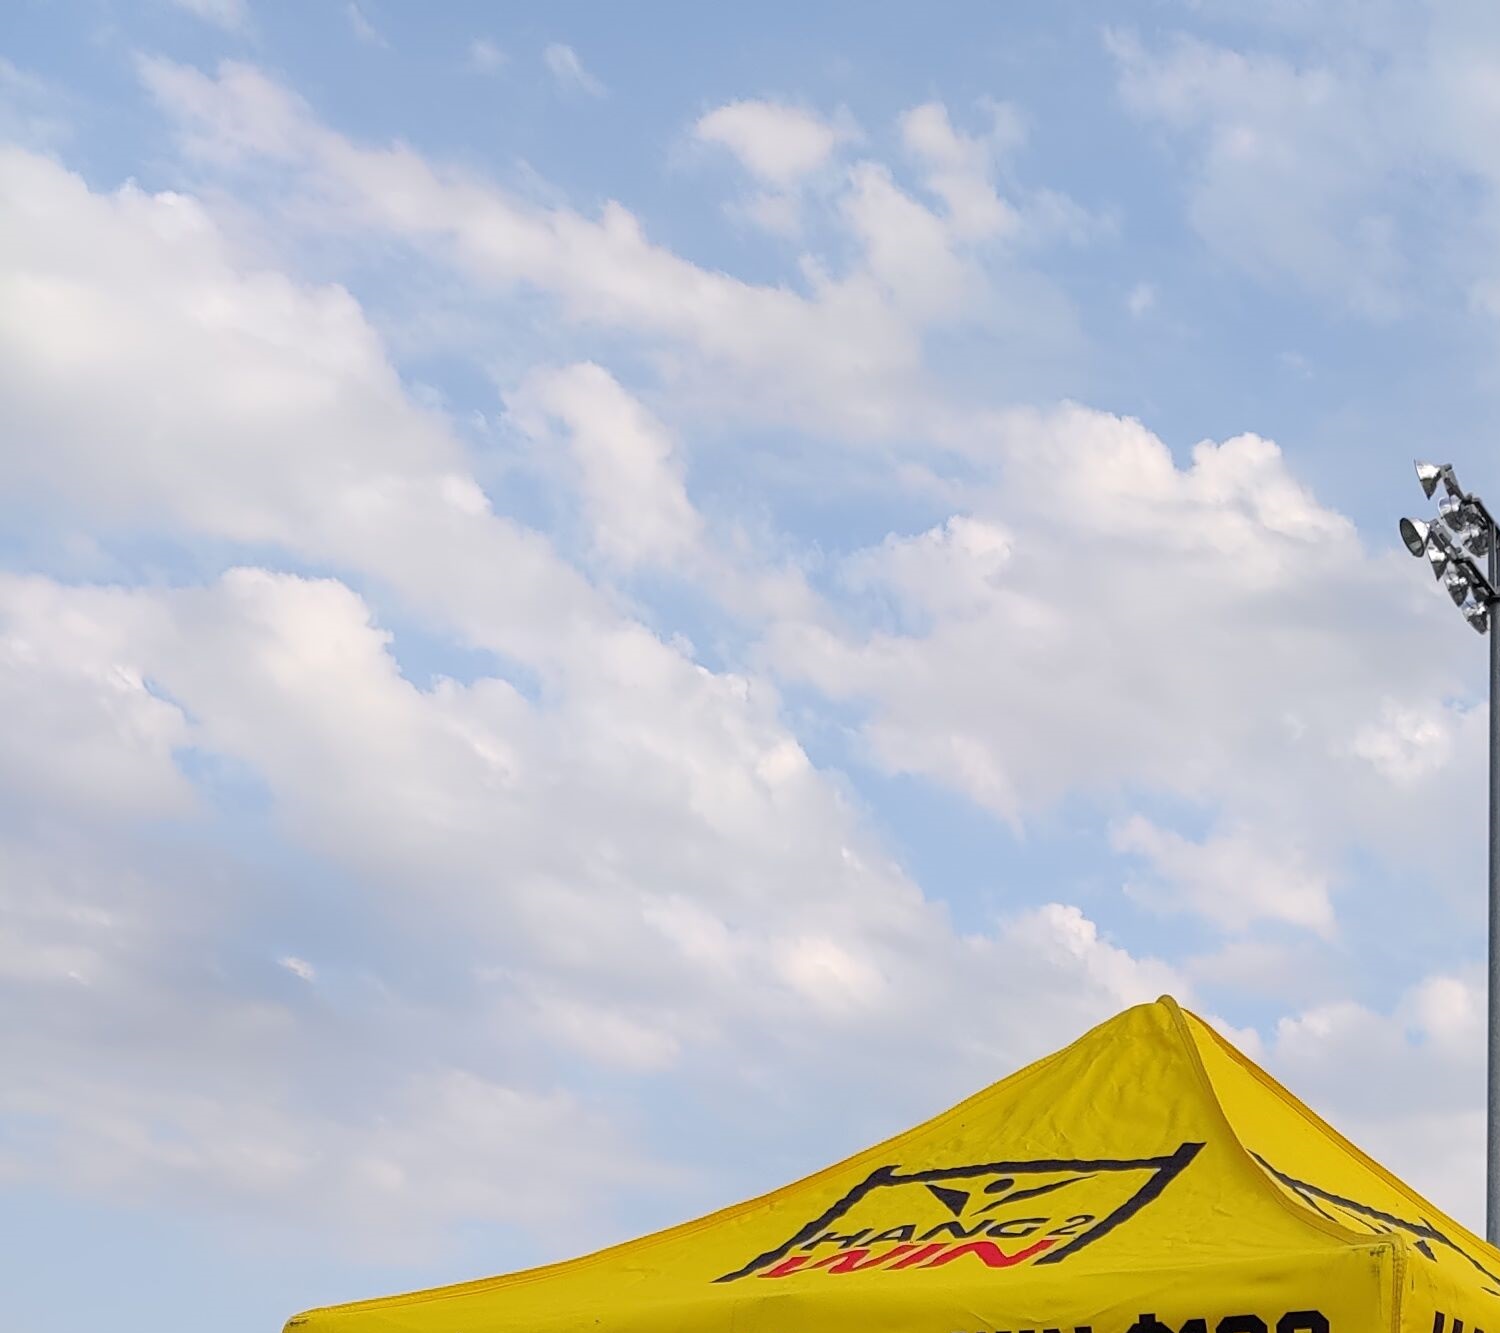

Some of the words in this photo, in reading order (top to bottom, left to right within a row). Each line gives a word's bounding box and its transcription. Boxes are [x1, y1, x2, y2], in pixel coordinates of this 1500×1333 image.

[801, 1216, 1051, 1250] HANG
[1055, 1214, 1096, 1238] 2
[756, 1240, 1060, 1278] WIN
